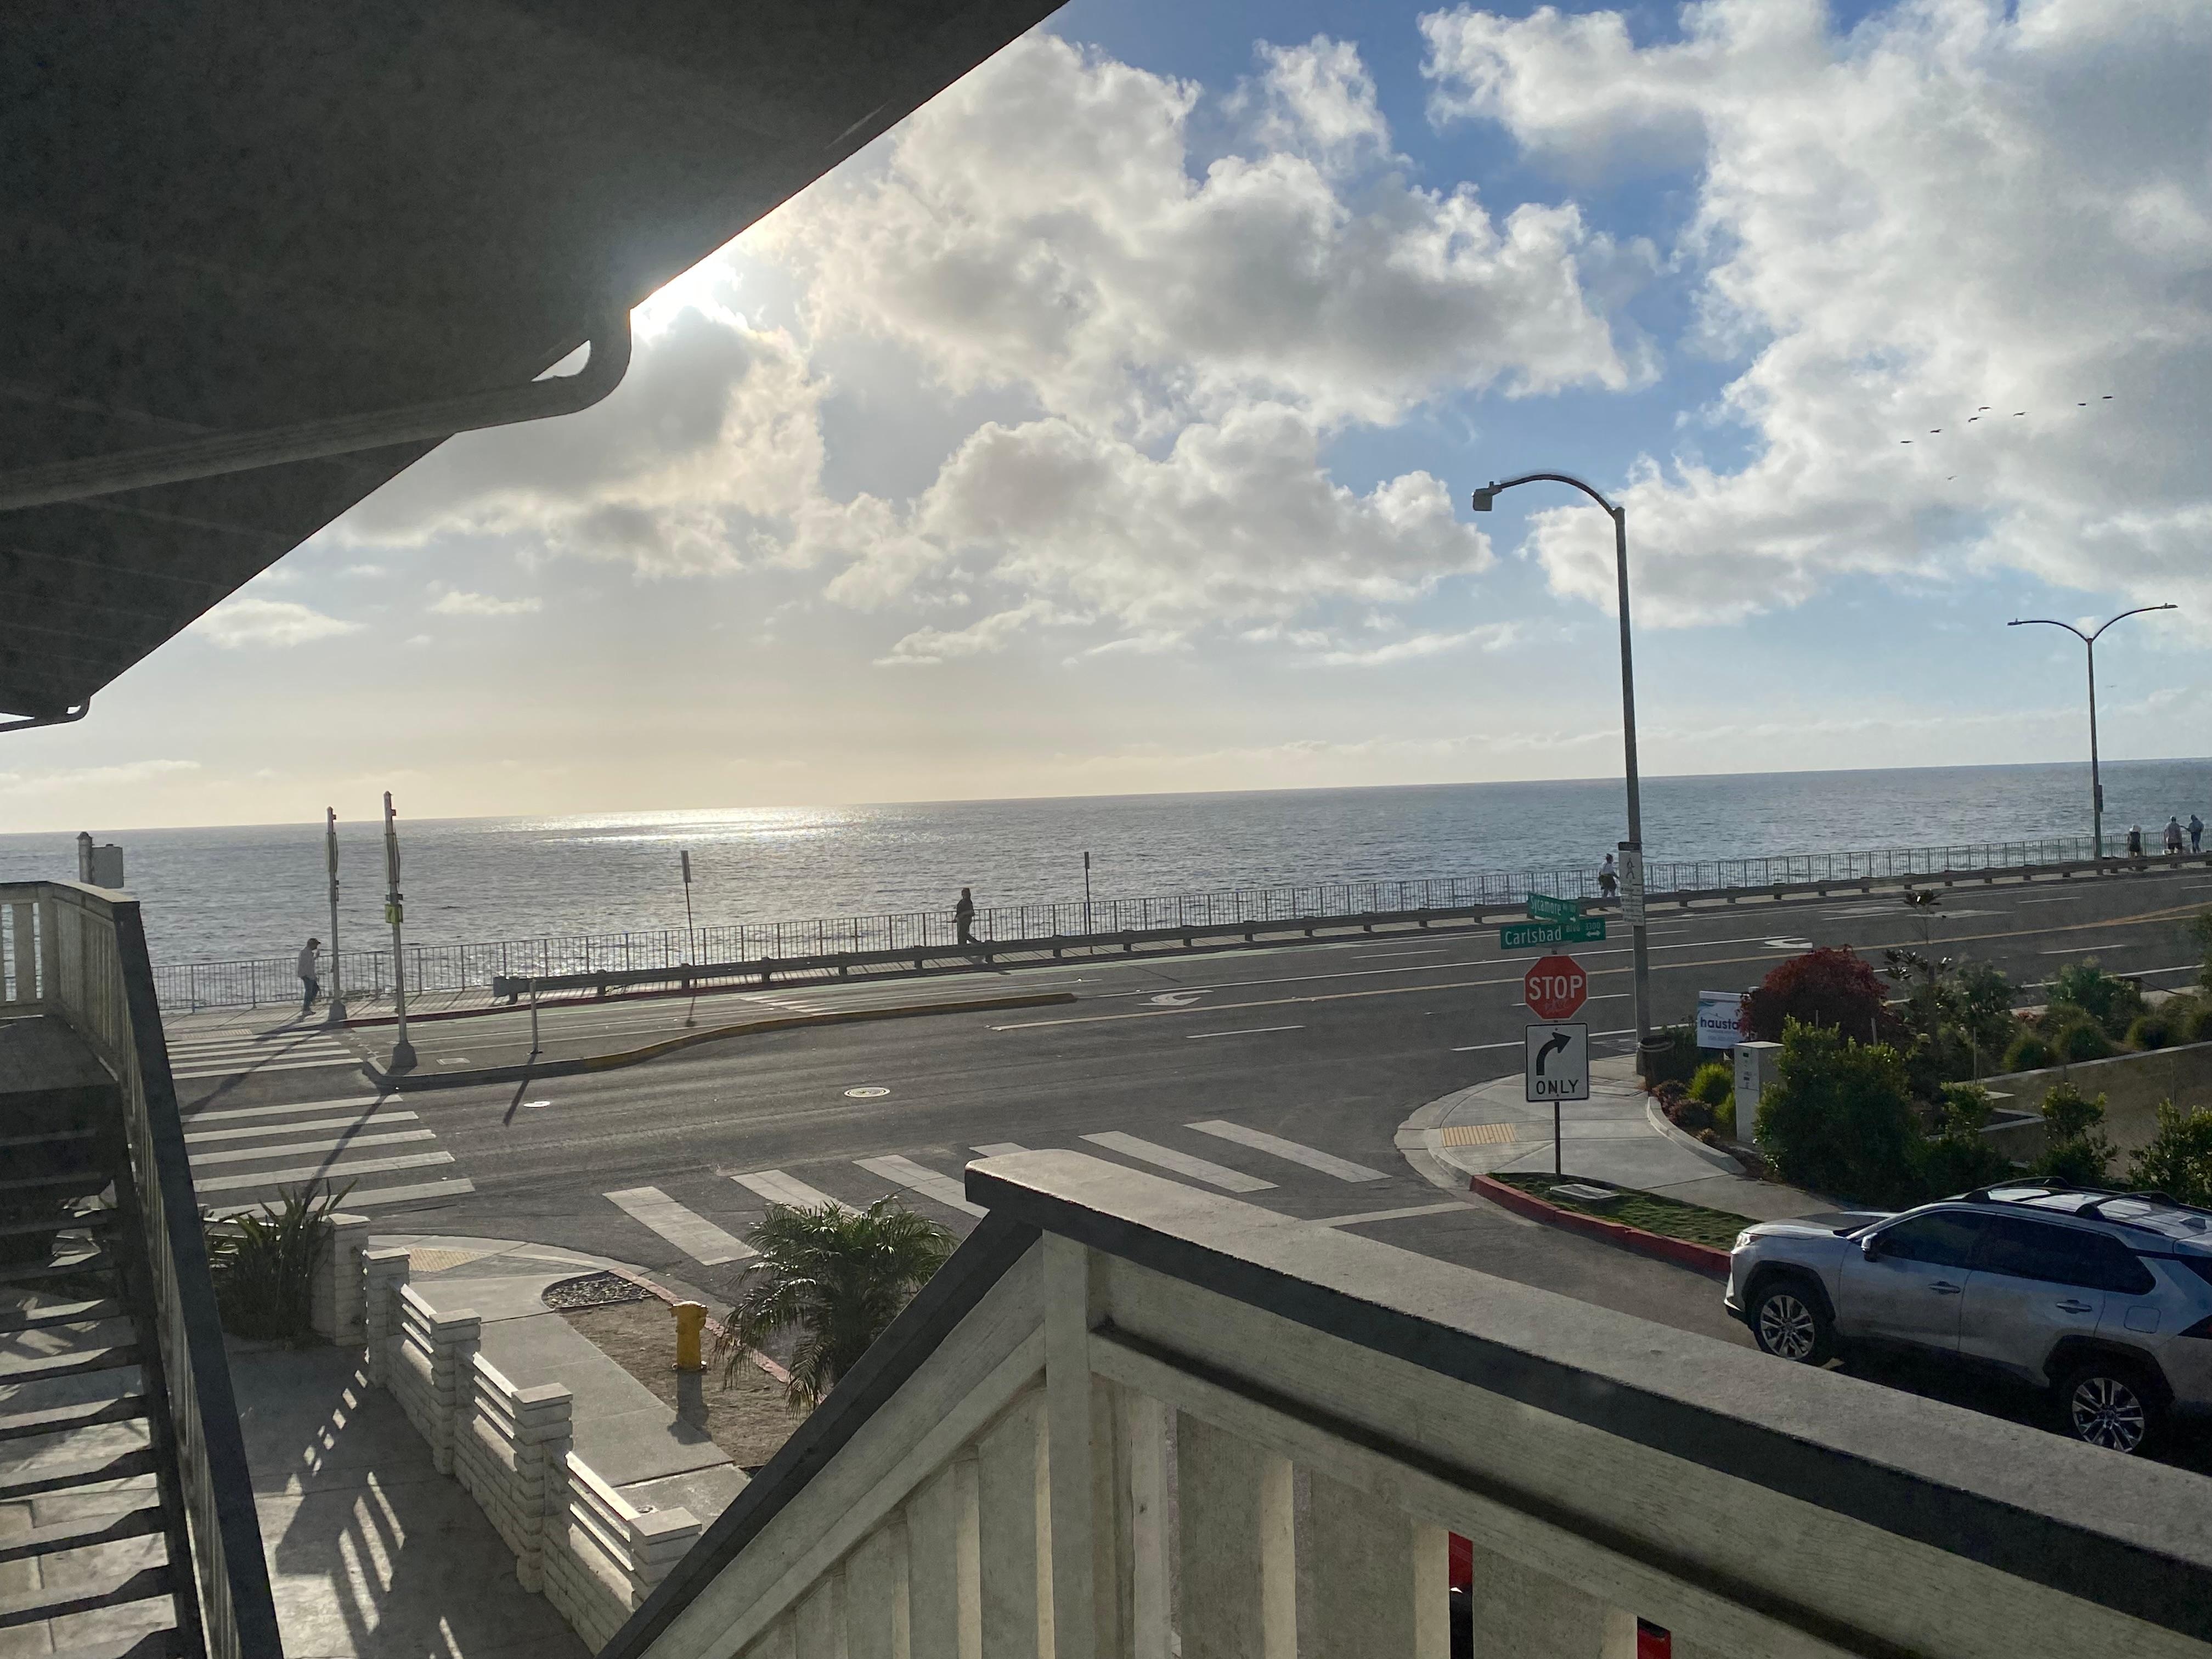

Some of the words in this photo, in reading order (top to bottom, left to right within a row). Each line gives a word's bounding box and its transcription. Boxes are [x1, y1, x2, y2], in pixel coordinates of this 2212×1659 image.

[1531, 895, 1561, 916] Sycamore
[1505, 925, 1562, 945] Carlsbad
[1528, 975, 1583, 1000] STOP
[1700, 1017, 1739, 1030] hausta
[1536, 1079, 1579, 1094] ONLY
